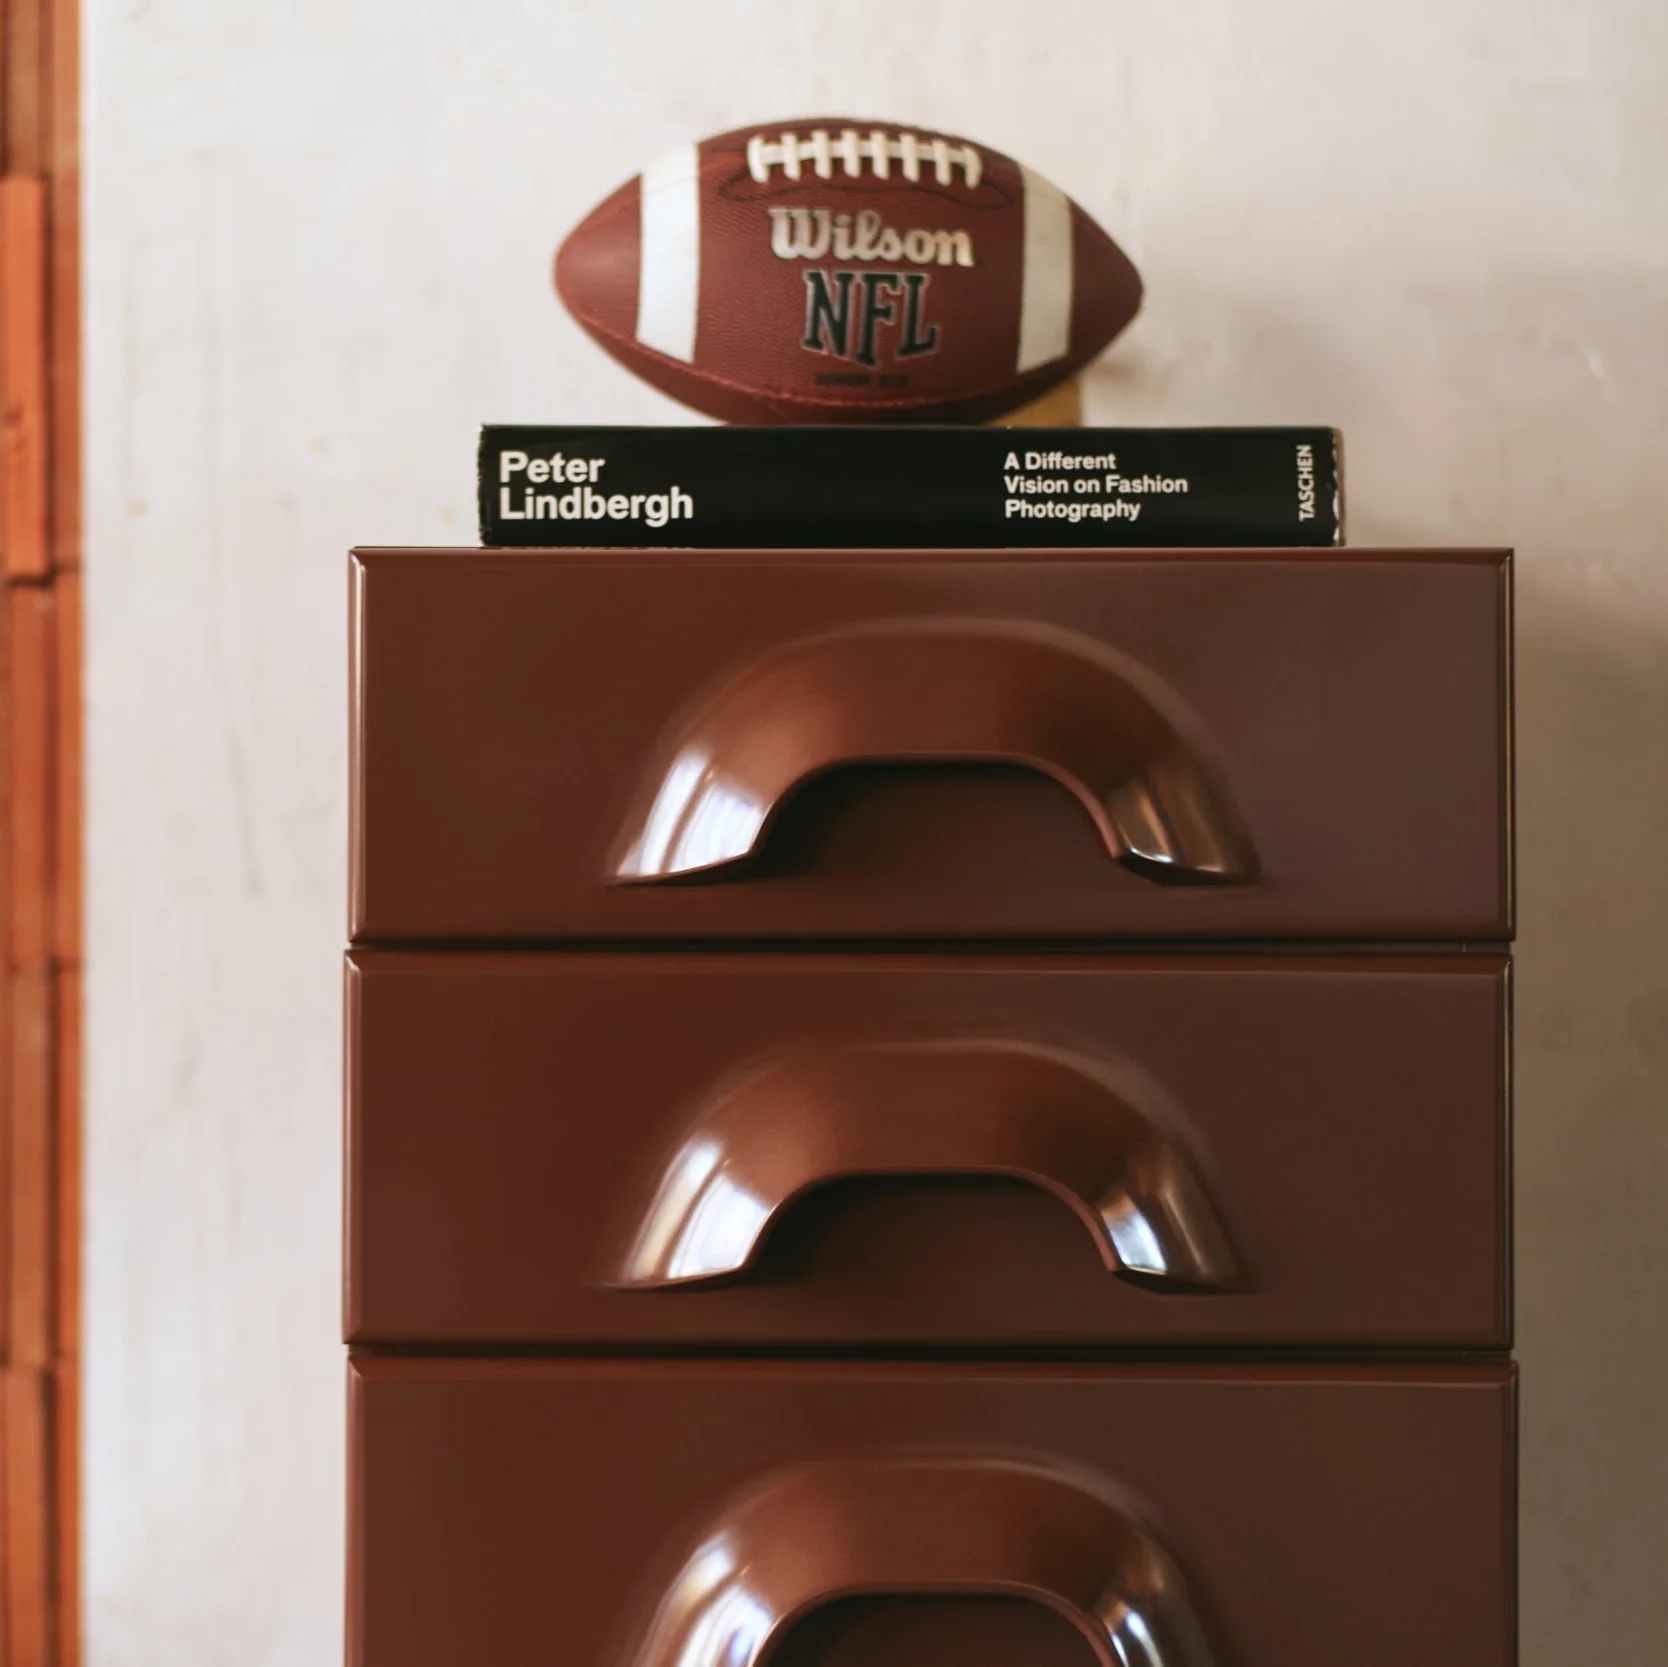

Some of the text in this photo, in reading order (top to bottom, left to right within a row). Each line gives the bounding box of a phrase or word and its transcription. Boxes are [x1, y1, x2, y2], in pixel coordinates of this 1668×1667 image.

[767, 206, 975, 267] Wilson
[802, 269, 941, 369] NFL
[499, 450, 606, 484] Peter
[1004, 451, 1117, 471] A Different
[1004, 475, 1189, 494] Vision on Fashion
[1297, 444, 1315, 522] TASCHEN
[499, 486, 694, 528] Lindbergh
[1005, 499, 1142, 523] Photography
